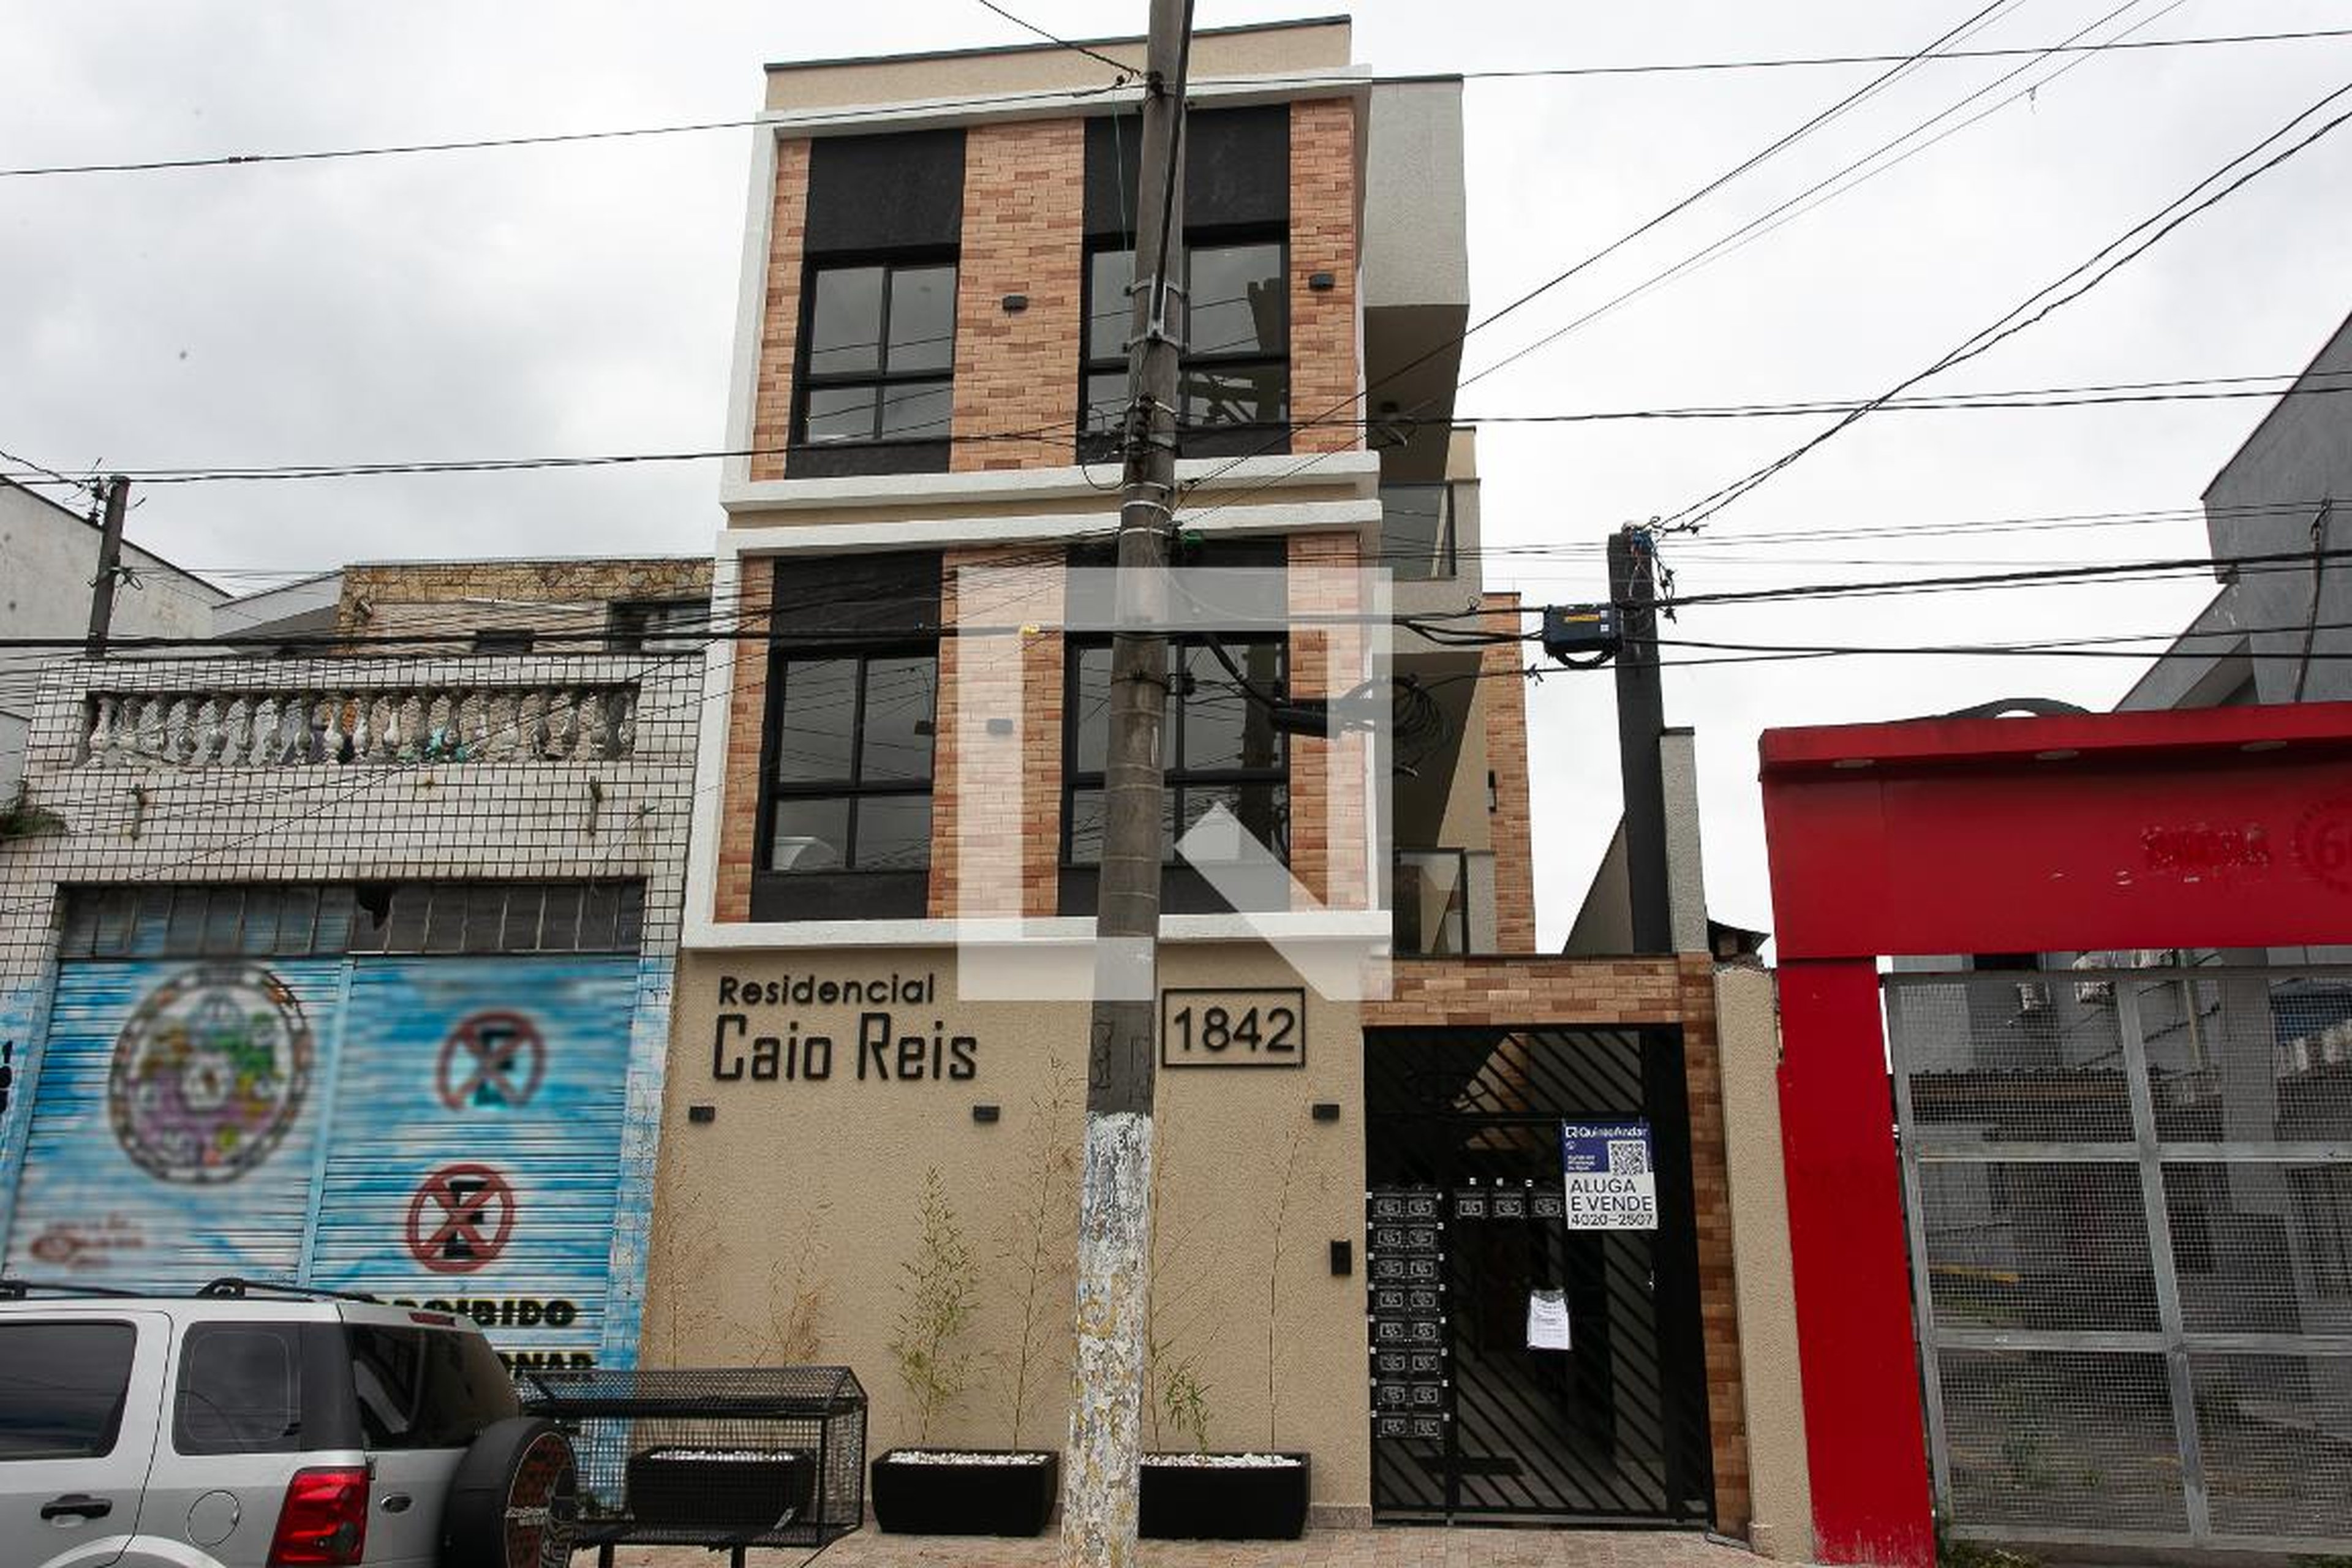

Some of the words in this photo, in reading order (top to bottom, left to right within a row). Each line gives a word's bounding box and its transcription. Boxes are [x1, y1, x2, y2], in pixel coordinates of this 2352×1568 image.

[718, 973, 935, 1005] Residencial
[1174, 1006, 1295, 1052] 1842
[713, 1014, 833, 1081] Caio
[858, 1012, 978, 1081] Reis
[1570, 1177, 1636, 1193] ALUGA
[1571, 1196, 1583, 1212] E
[1586, 1196, 1653, 1212] VENDE
